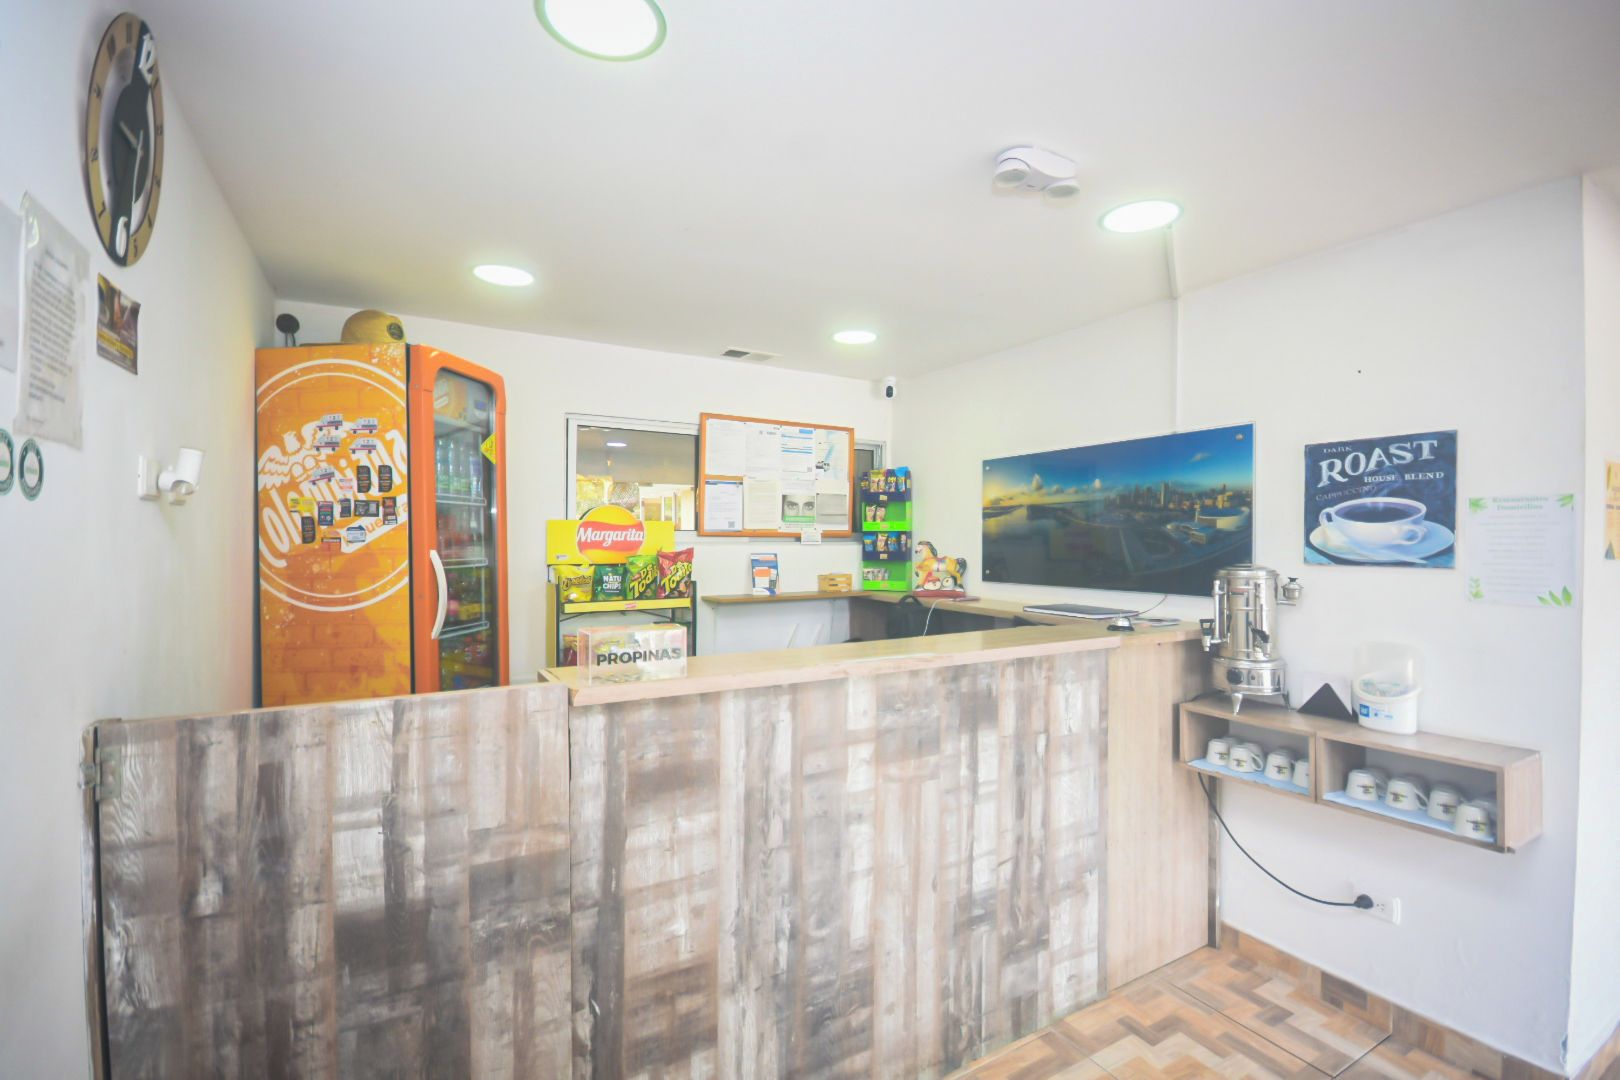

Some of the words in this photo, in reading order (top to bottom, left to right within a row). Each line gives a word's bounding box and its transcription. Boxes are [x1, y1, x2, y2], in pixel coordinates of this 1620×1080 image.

[138, 32, 157, 86] 12
[115, 215, 129, 259] 6
[1323, 445, 1352, 454] DARK
[1316, 439, 1438, 488] ROAST
[1363, 473, 1402, 483] HOUSE
[1404, 471, 1445, 481] BLEND
[1315, 485, 1377, 502] CAPPUCCINO
[576, 527, 645, 547] Margarita
[602, 575, 623, 583] NATU
[602, 582, 622, 590] CHIPS
[596, 647, 682, 667] PROPINAS
